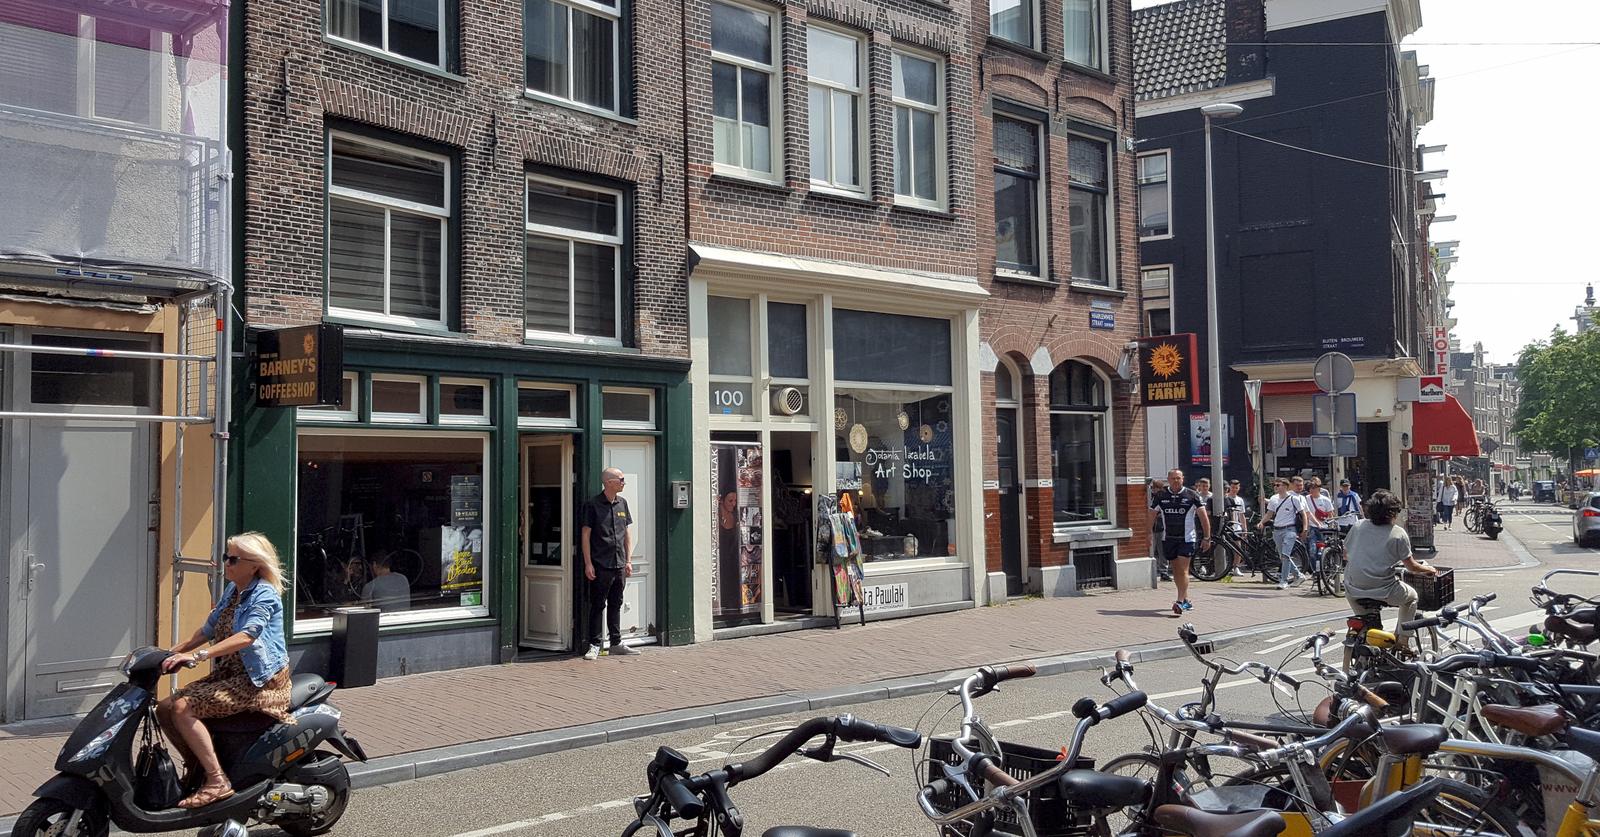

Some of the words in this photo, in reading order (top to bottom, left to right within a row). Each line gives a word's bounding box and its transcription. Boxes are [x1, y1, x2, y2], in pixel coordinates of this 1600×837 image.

[1435, 327, 1448, 386] HOTE
[260, 357, 316, 377] BARNEY'S
[260, 381, 316, 400] COFFEESHOP
[1148, 381, 1186, 389] BARNEY'S
[1148, 387, 1186, 401] FARM
[1421, 388, 1444, 396] Marlboro
[714, 390, 744, 406] 100
[875, 462, 896, 478] Art
[902, 462, 932, 484] Shop
[875, 584, 904, 605] Pawlak
